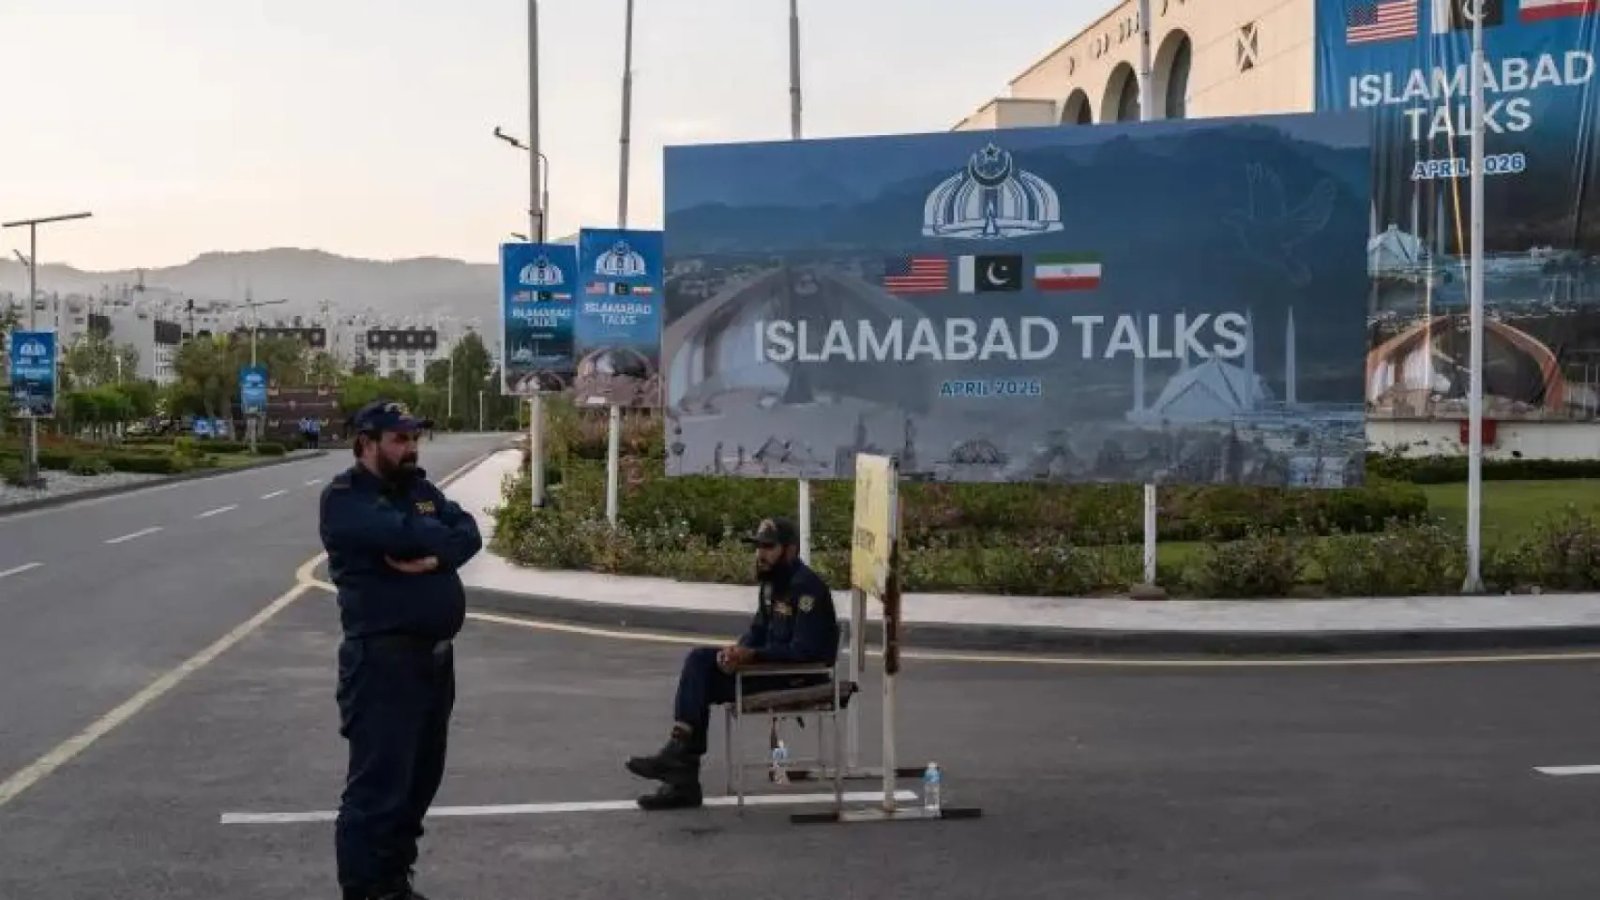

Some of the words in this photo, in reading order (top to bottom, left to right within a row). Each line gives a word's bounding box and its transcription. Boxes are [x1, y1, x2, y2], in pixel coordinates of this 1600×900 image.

[1349, 51, 1594, 109] ISLAMABAD
[1403, 97, 1532, 141] TALKS
[1483, 152, 1526, 174] 026
[754, 316, 1058, 363] ISLAMABAD
[1071, 311, 1249, 359] TALKS
[940, 380, 989, 396] APRIL
[994, 379, 1041, 396] 2026
